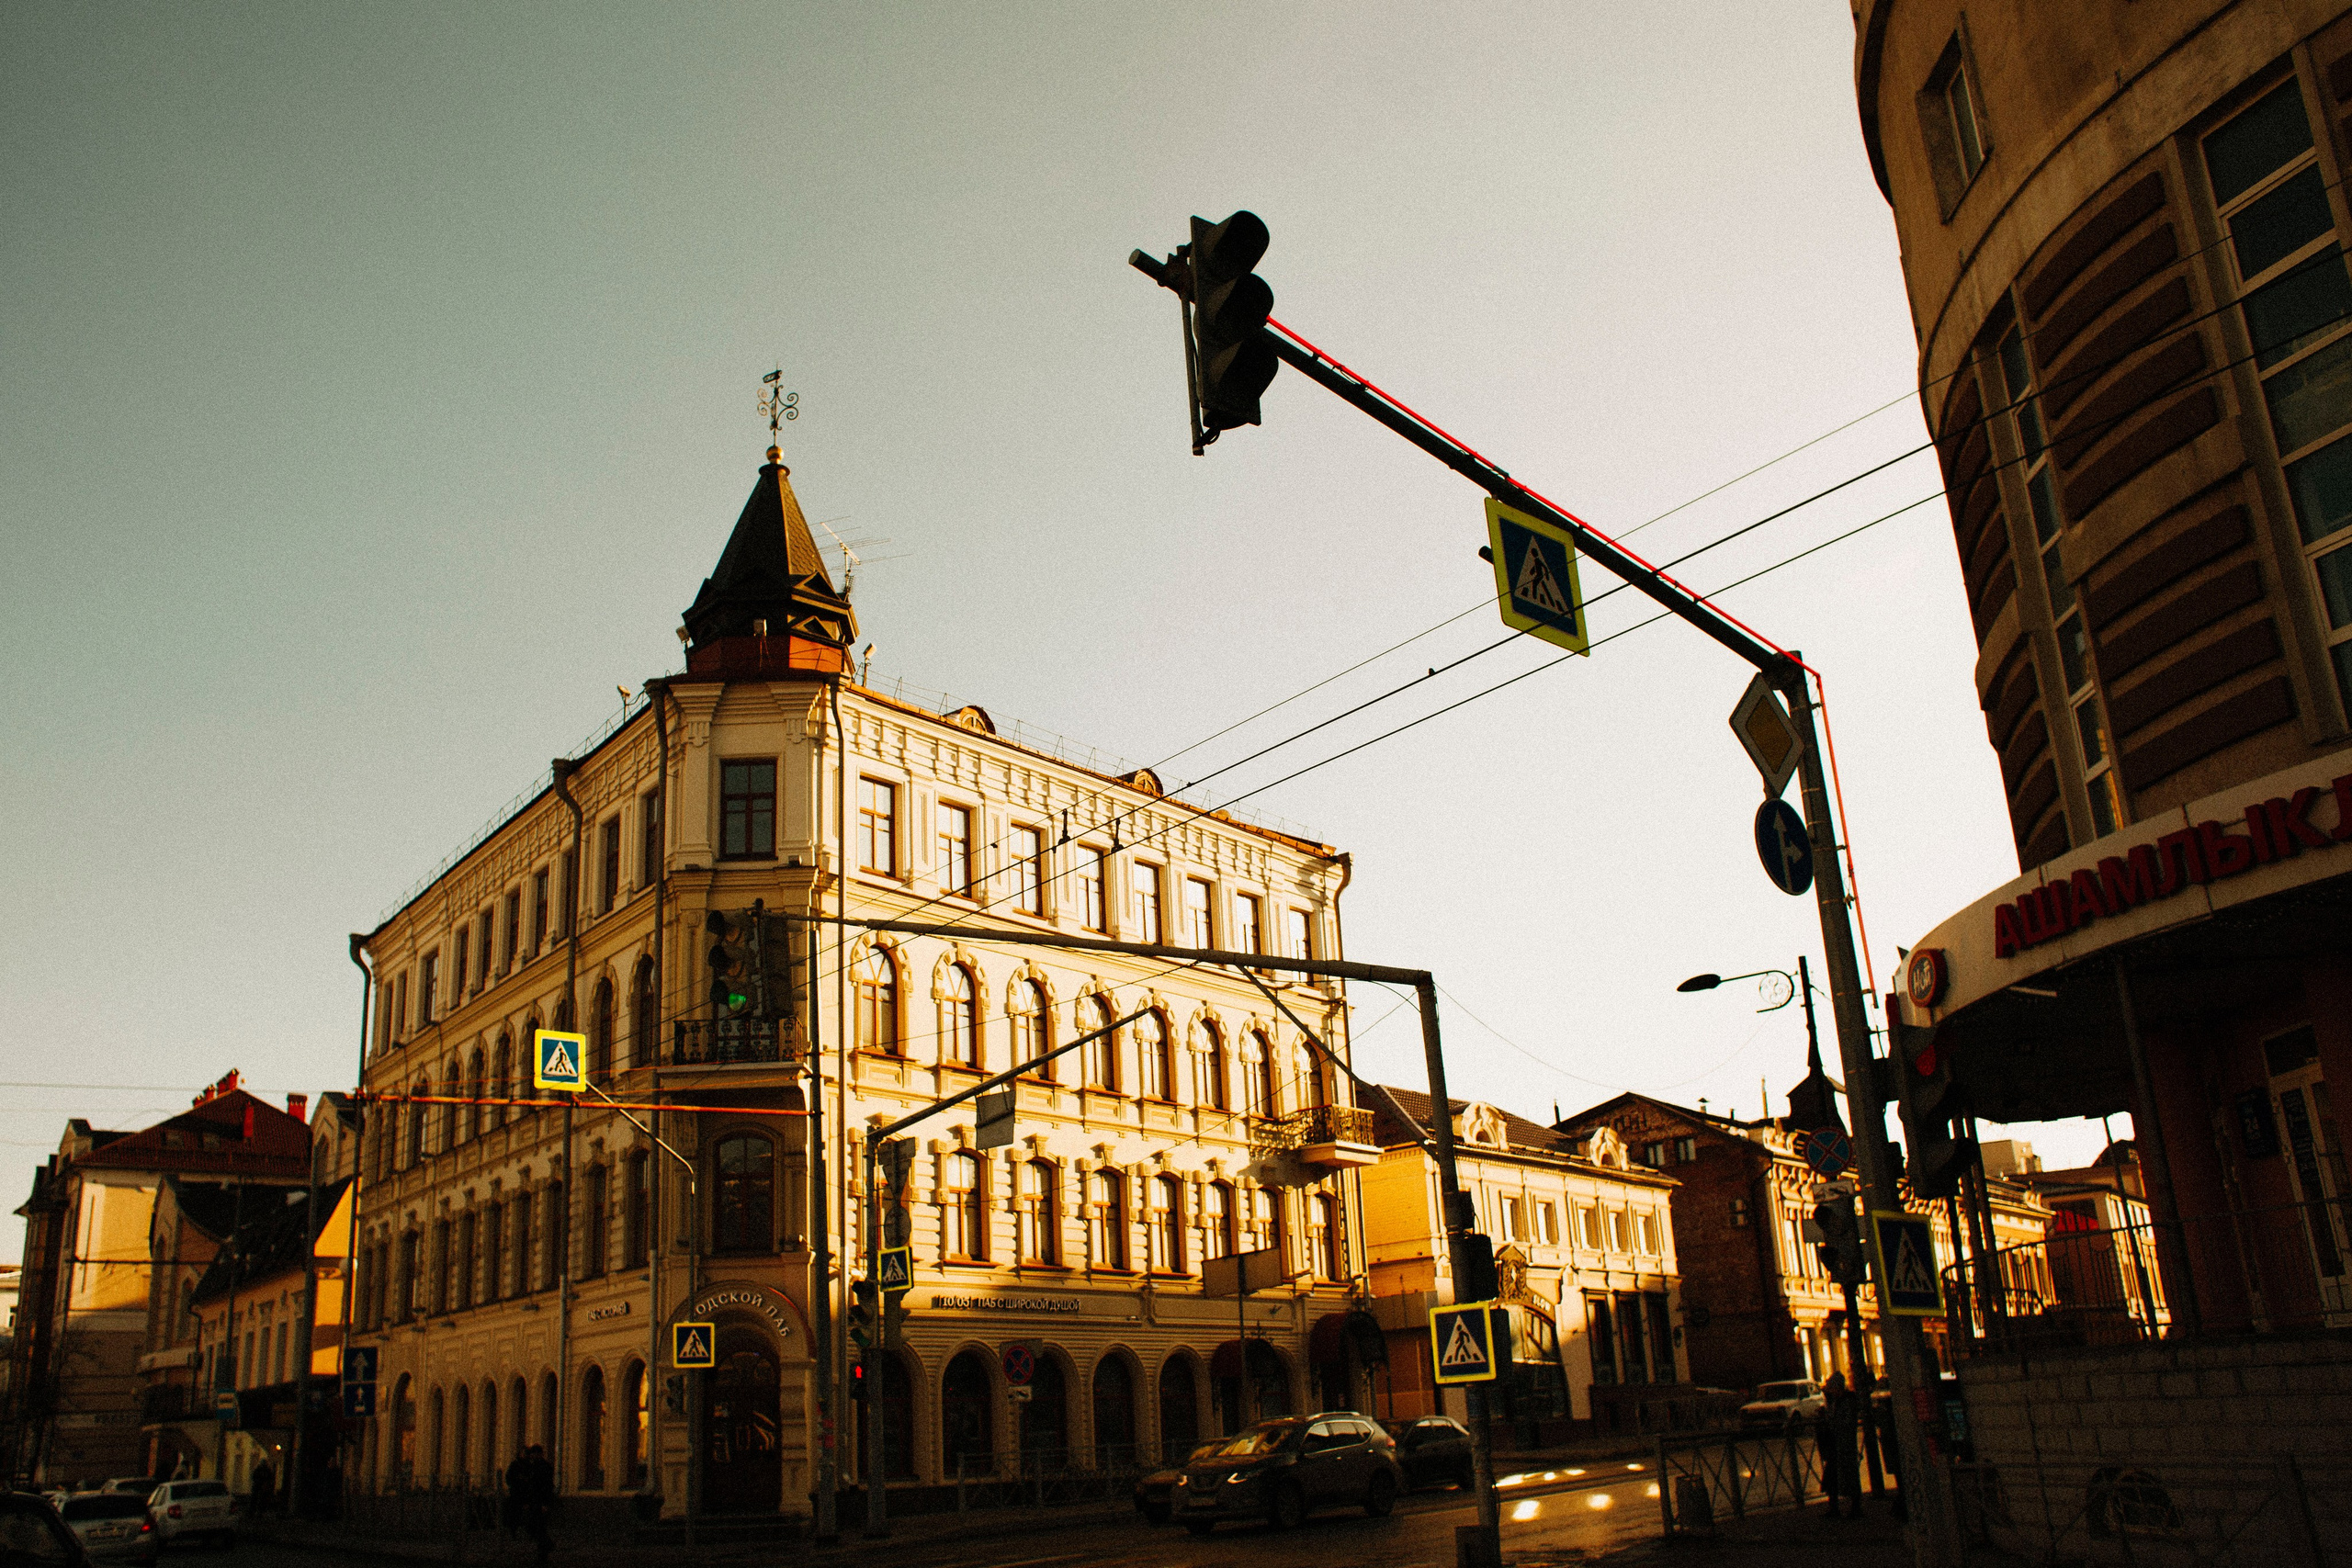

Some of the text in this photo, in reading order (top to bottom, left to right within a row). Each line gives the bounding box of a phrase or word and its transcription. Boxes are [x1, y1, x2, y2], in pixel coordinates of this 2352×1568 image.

[695, 1292, 790, 1337] ОДСКОЙ ПАБ
[978, 1297, 996, 1308] ПАБ
[1005, 1297, 1048, 1310] ШИРОКОЙ
[1049, 1298, 1081, 1312] ДУШОЙ
